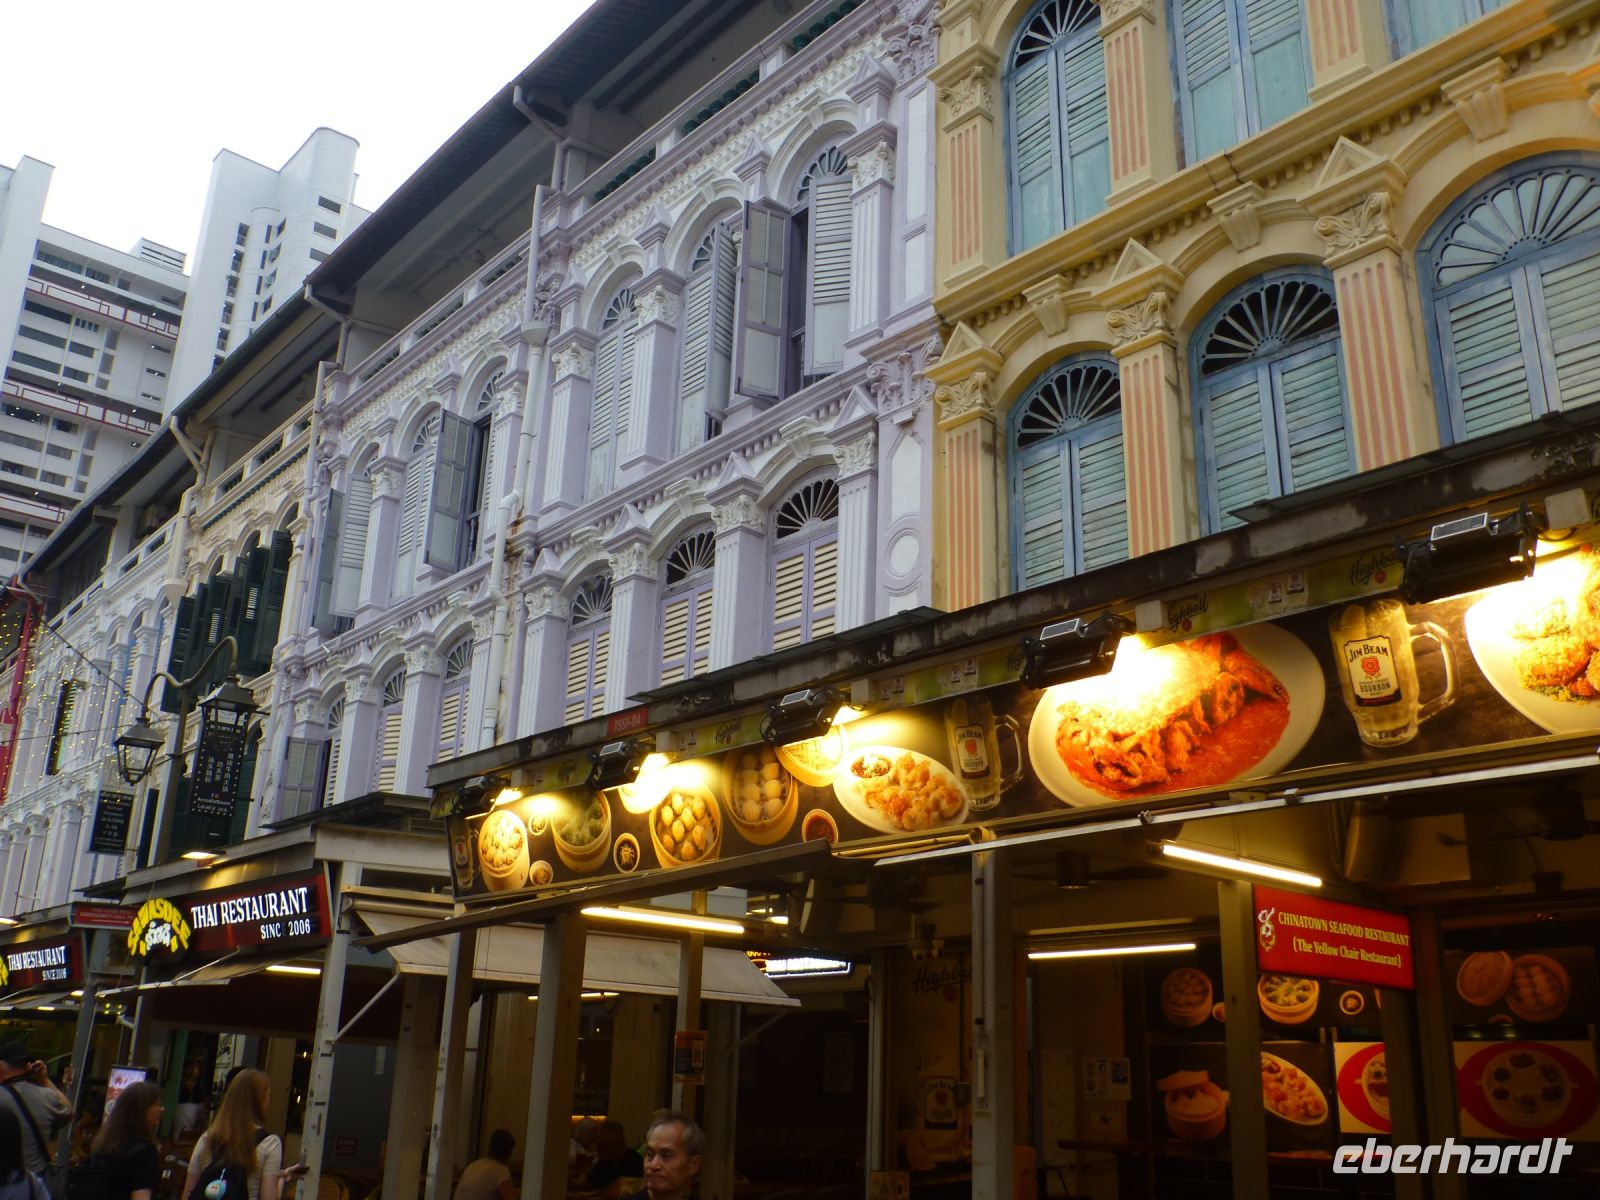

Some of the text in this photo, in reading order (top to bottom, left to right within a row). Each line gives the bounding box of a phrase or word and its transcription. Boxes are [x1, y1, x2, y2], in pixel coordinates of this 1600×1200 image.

[1349, 643, 1389, 662] JIM BEAM
[191, 887, 308, 929] THAI RESTAURANT
[260, 918, 311, 940] SINC 2006
[1278, 911, 1410, 947] CHINATOWN SEAFOOD RESTAURANT
[7, 953, 22, 971] THAI
[22, 946, 66, 969] RESTAURANT
[1293, 936, 1402, 968] (The Yellow Chair Restaurant)
